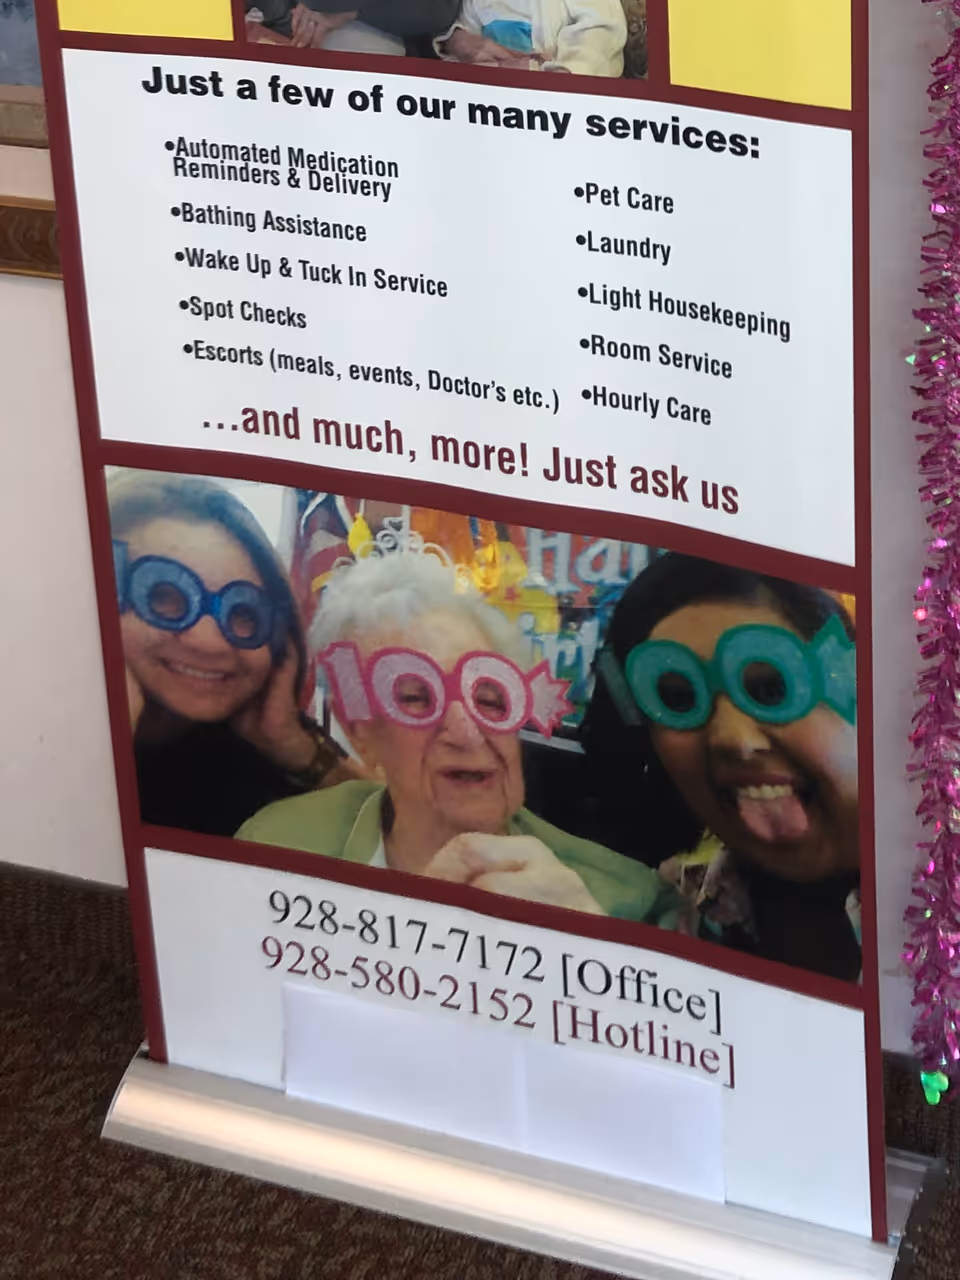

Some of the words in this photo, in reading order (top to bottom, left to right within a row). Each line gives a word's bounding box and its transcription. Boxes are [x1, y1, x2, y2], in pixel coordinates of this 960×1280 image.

[142, 66, 224, 98] Just
[236, 78, 258, 101] a
[268, 75, 335, 108] few
[347, 84, 384, 113] of
[396, 94, 456, 121] our
[467, 101, 572, 139] many
[585, 116, 760, 159] services:
[173, 156, 281, 186] Reminders
[287, 168, 301, 189] &
[308, 171, 392, 203] Delivery
[287, 146, 399, 178] Medication
[627, 186, 675, 214] Care
[263, 210, 367, 242] Assistance
[246, 252, 272, 279] Up
[279, 257, 293, 278] &
[298, 259, 342, 285] Tuck
[348, 265, 368, 288] In
[373, 268, 448, 298] Service
[240, 300, 308, 329] Checks
[648, 290, 792, 343] Housekeeping
[269, 347, 342, 382] (meals,
[349, 363, 421, 392] events,
[428, 369, 507, 403] Doctor's
[512, 386, 561, 415] etc.)
[658, 343, 733, 379] Service
[666, 396, 712, 426] Care
[313, 417, 418, 463] much,
[431, 433, 529, 477] more!
[542, 446, 618, 489] Just
[630, 464, 690, 503] ask
[700, 478, 740, 515] us
[267, 888, 546, 984] 928-817-7172
[560, 952, 723, 1036] [Office]
[260, 934, 537, 1030] 928-580-2152
[551, 999, 737, 1090] [Hotline]
